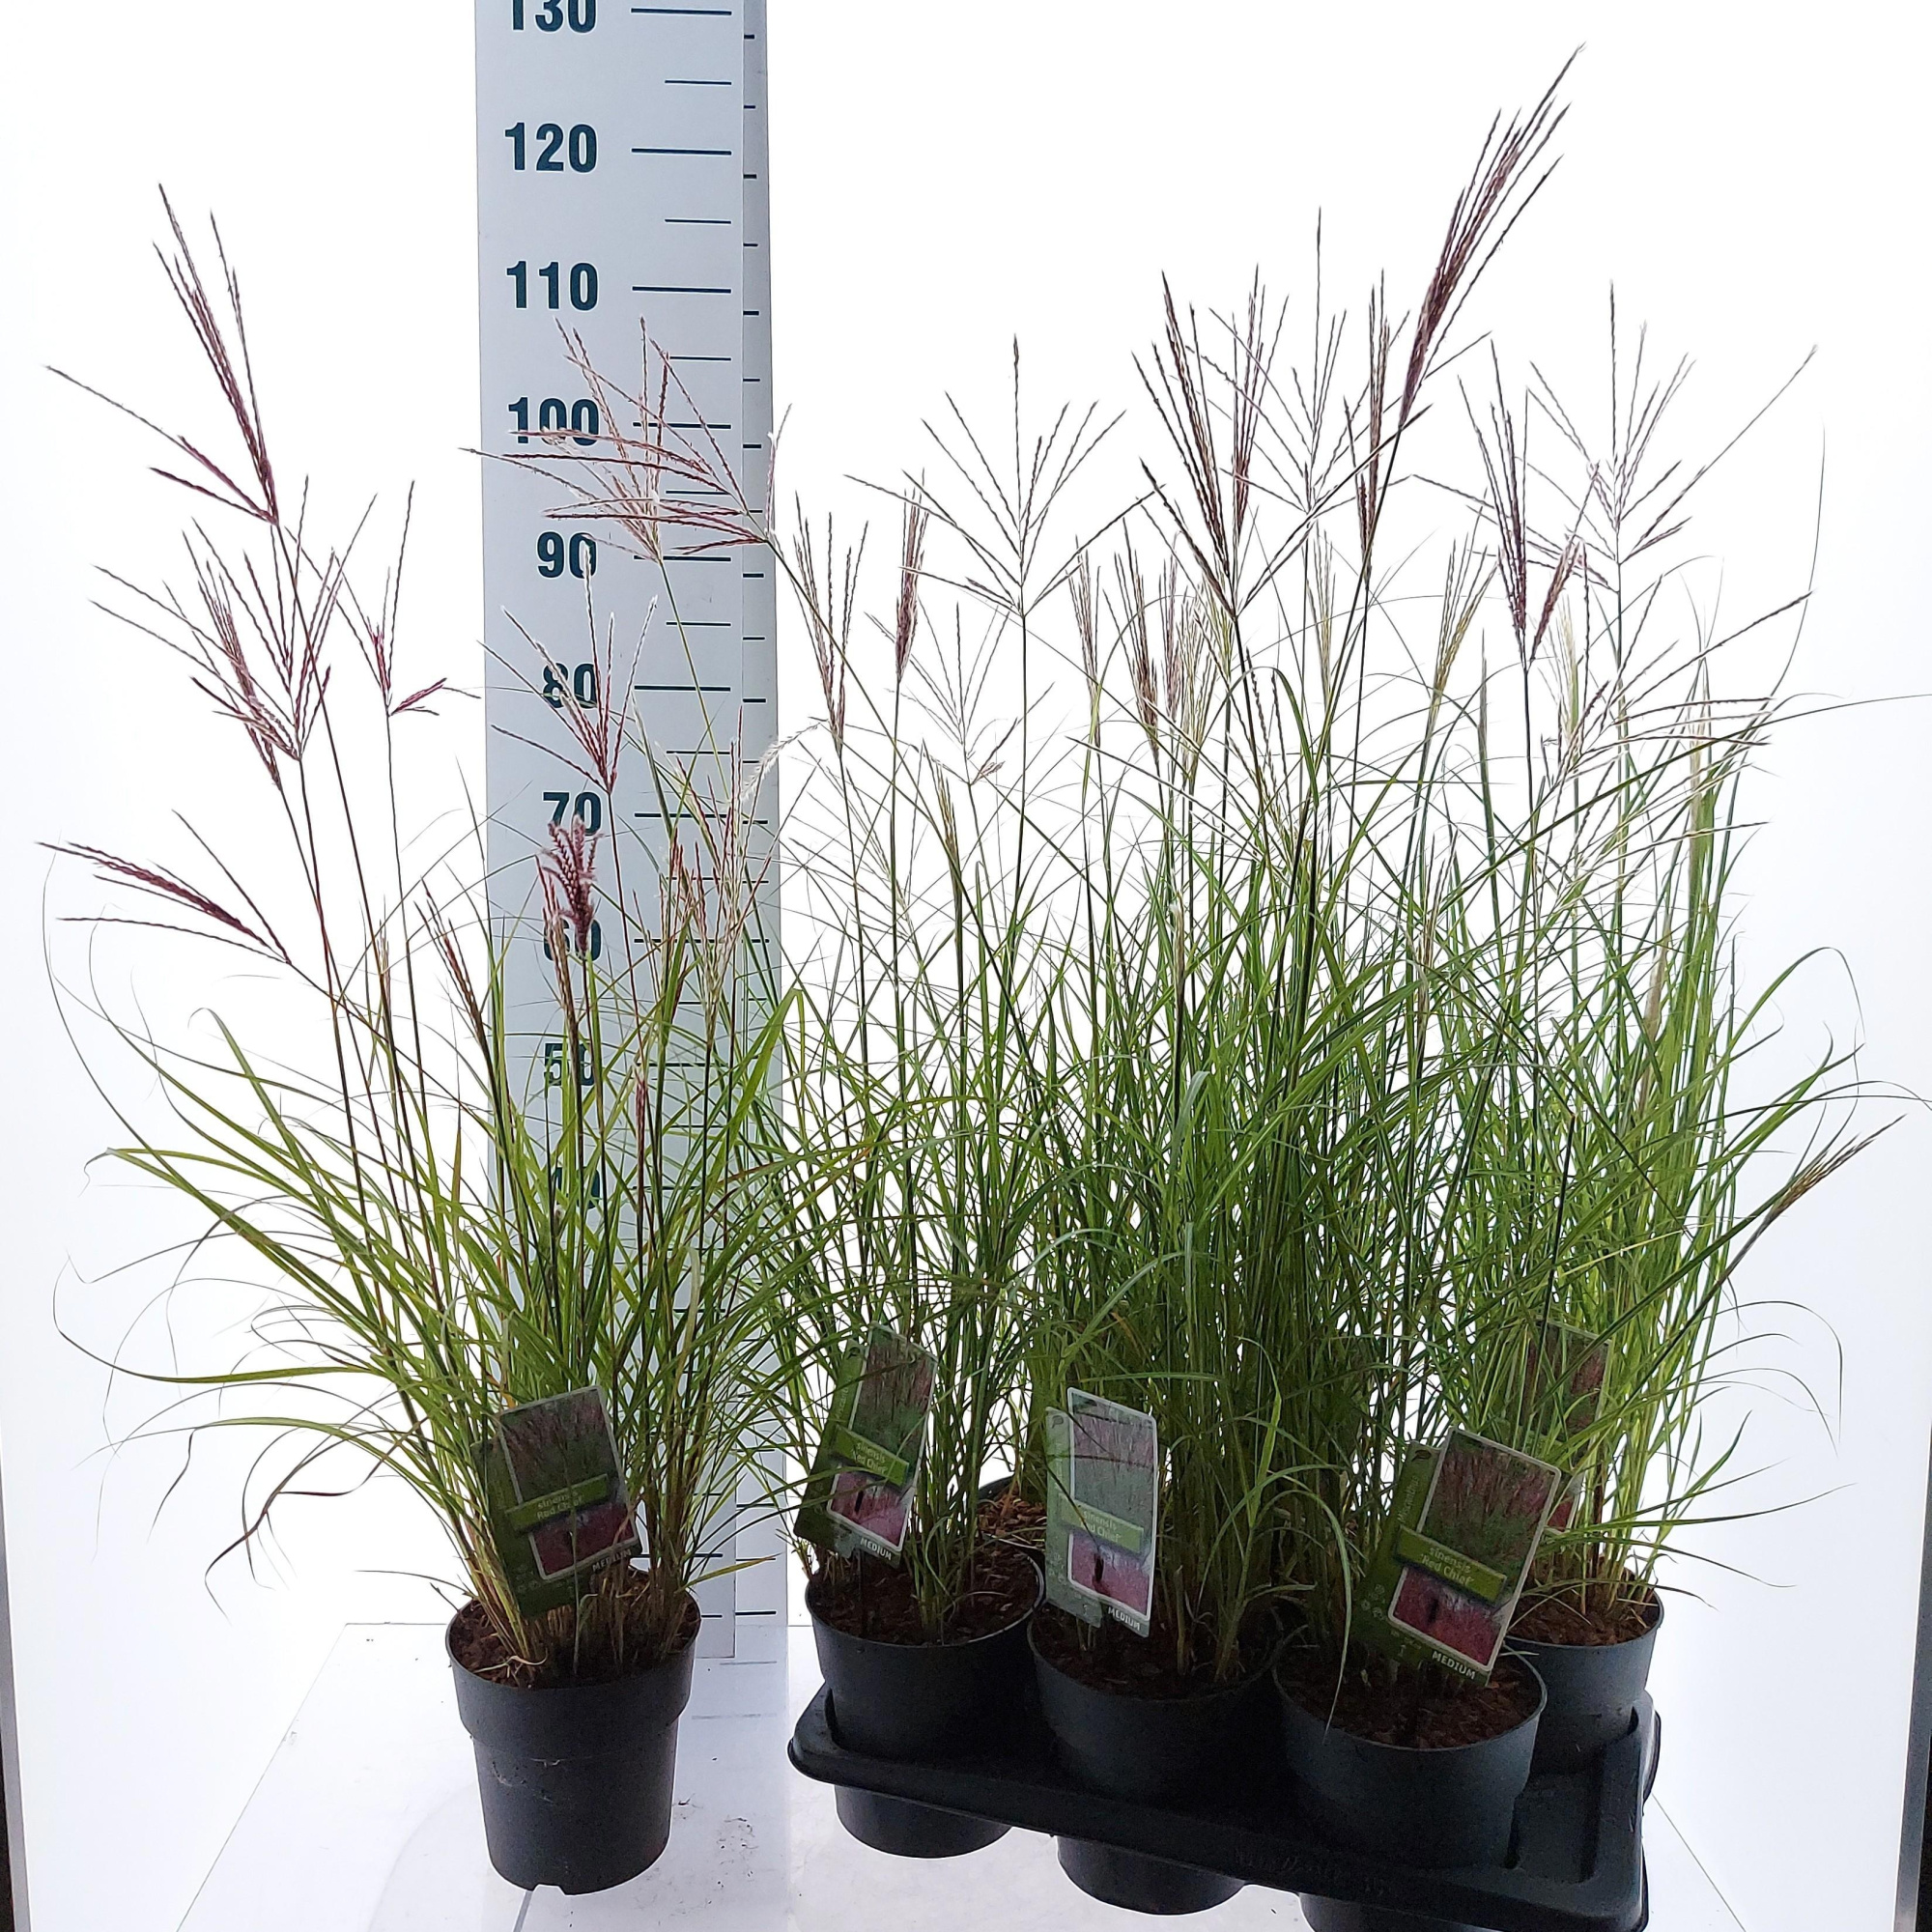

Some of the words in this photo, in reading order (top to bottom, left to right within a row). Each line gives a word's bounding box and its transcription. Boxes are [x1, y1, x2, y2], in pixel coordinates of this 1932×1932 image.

[511, 0, 597, 33] 130
[504, 122, 597, 173] 120
[506, 261, 598, 311] 110
[508, 397, 599, 445] 100
[537, 531, 597, 579] 90
[543, 663, 599, 709] 80
[543, 791, 601, 837] 70
[860, 1537, 893, 1561] MEDIUM
[1430, 1548, 1471, 1574] sinensis
[1107, 1605, 1142, 1632] MEDIUM
[1433, 1650, 1476, 1680] MEDIUM
